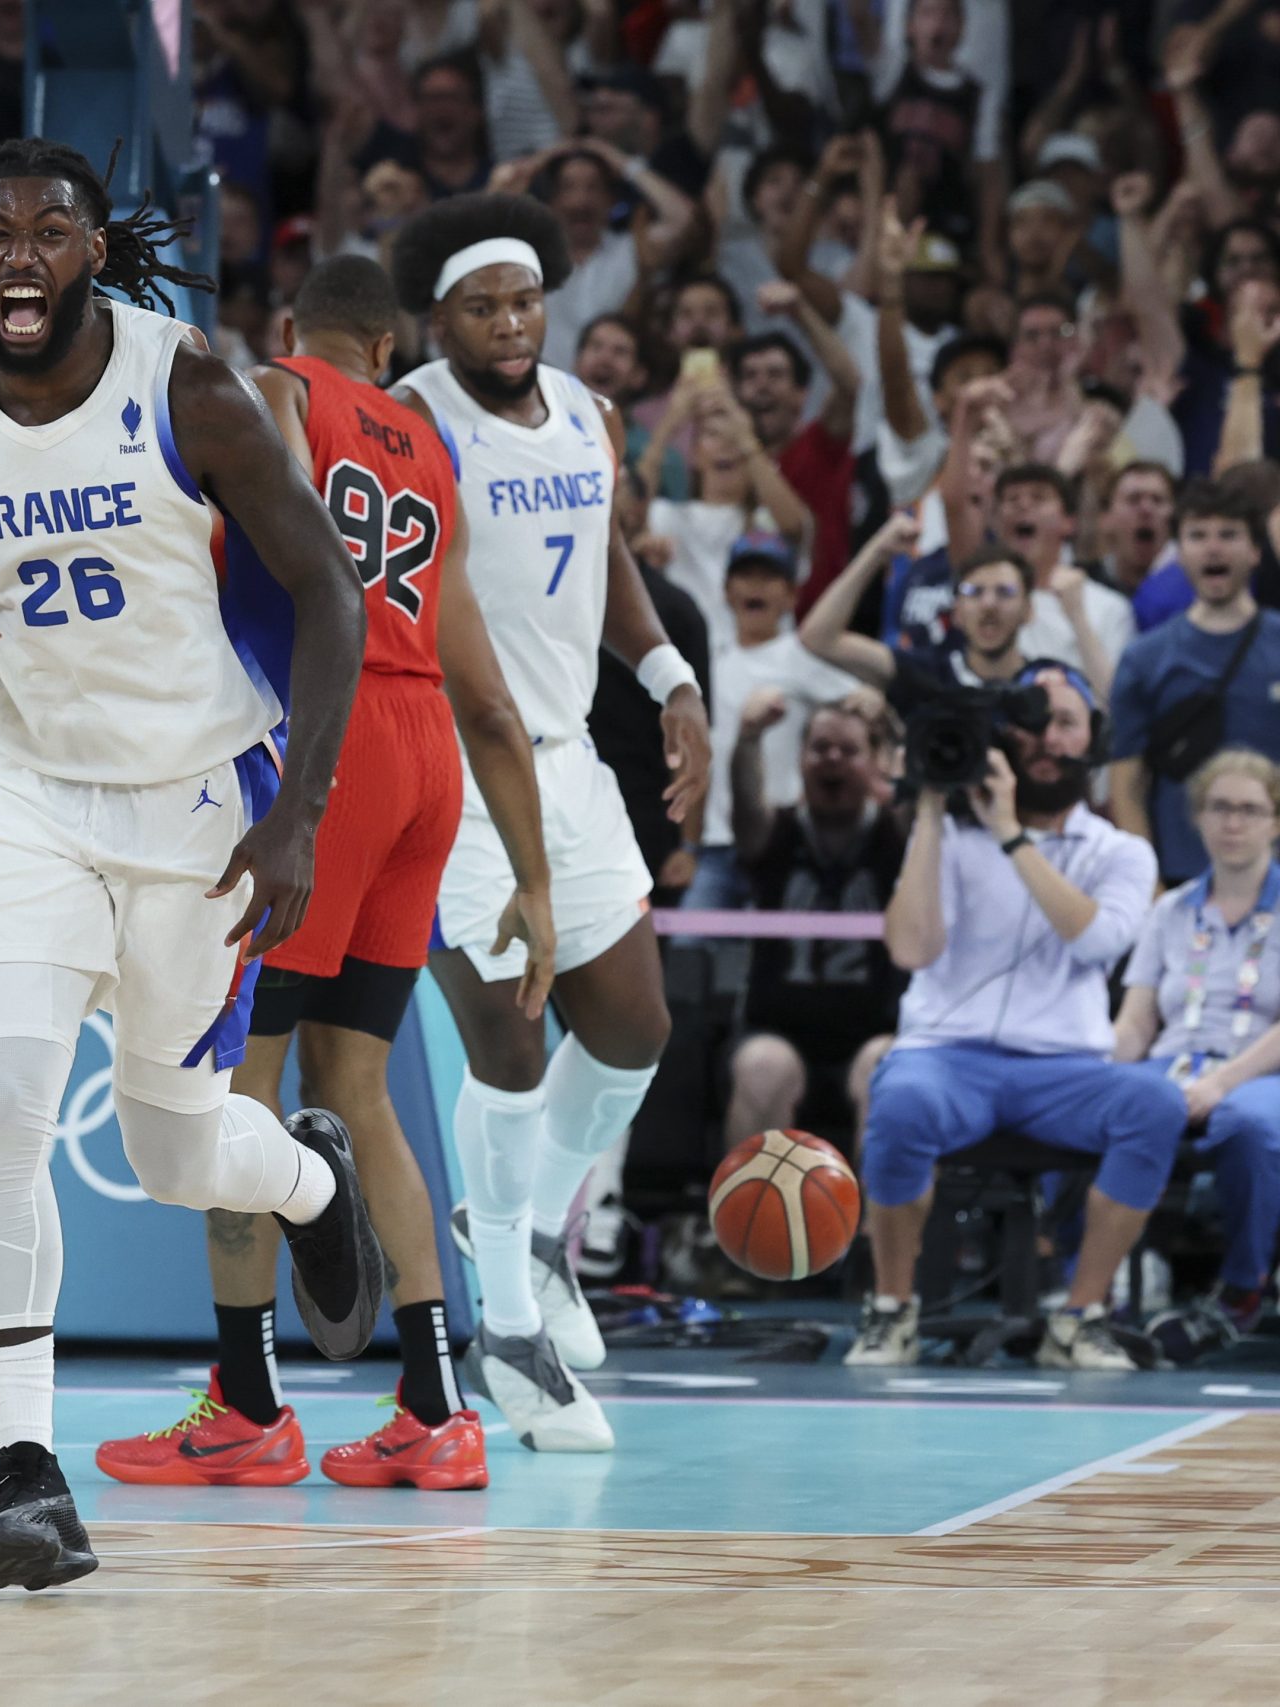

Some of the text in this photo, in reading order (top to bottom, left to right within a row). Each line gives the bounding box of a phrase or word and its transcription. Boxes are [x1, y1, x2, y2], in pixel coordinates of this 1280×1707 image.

[119, 441, 147, 455] FRANCE
[489, 471, 605, 516] FRANCE
[325, 458, 440, 625] 92
[545, 534, 575, 597] 7
[17, 557, 126, 627] 26
